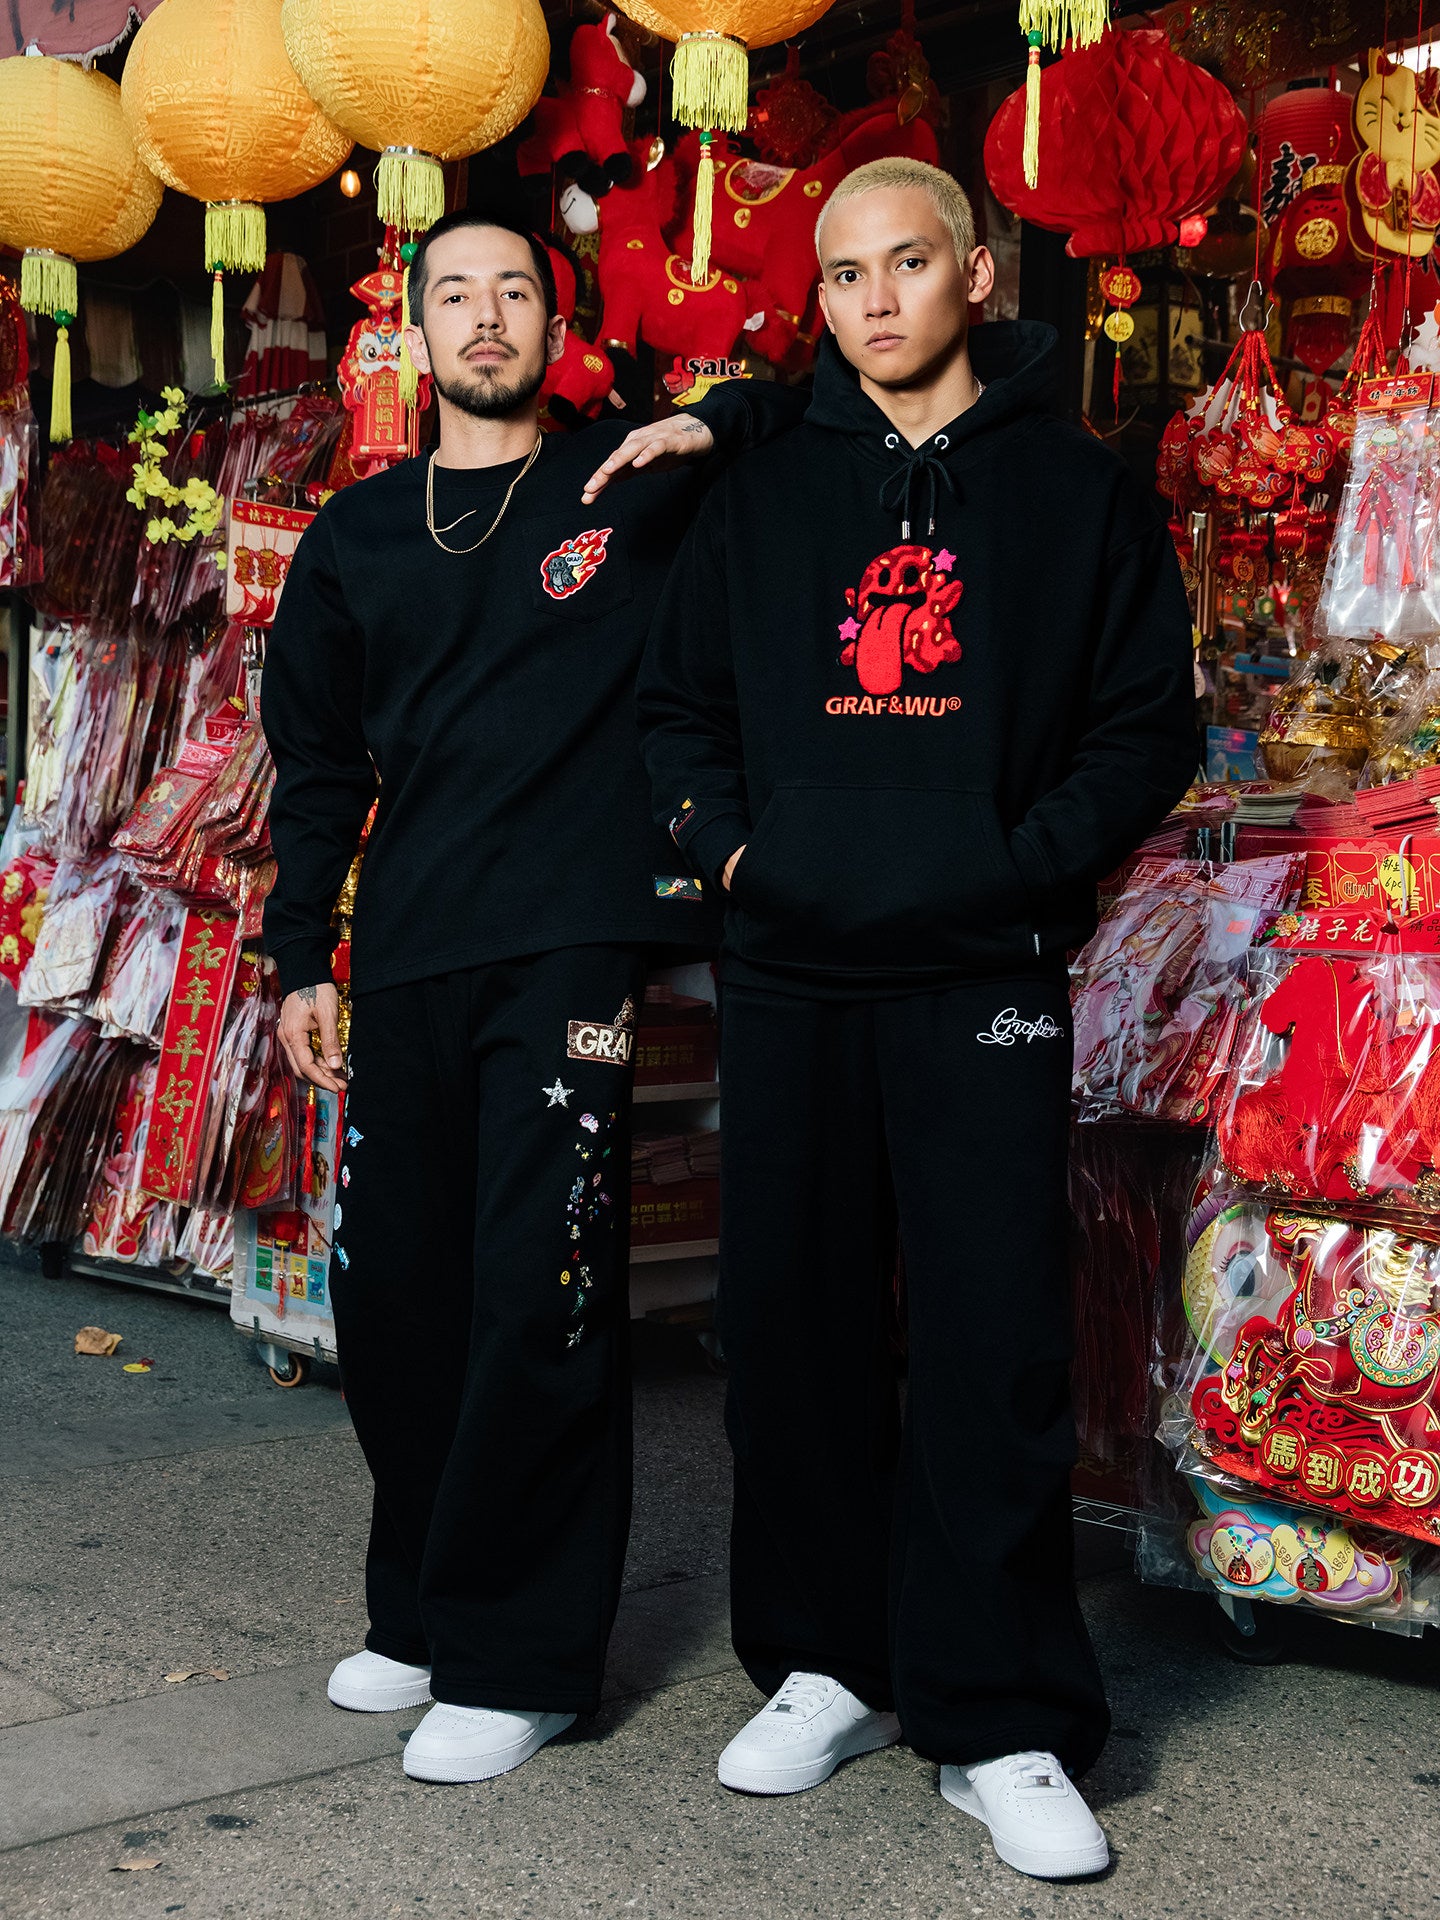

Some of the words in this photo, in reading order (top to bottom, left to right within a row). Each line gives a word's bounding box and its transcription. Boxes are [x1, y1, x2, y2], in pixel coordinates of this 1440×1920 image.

[375, 372, 395, 442] 五福临门
[1300, 918, 1374, 942] 桔子花
[575, 1026, 634, 1061] GRA
[1266, 1432, 1432, 1499] 馬到成功
